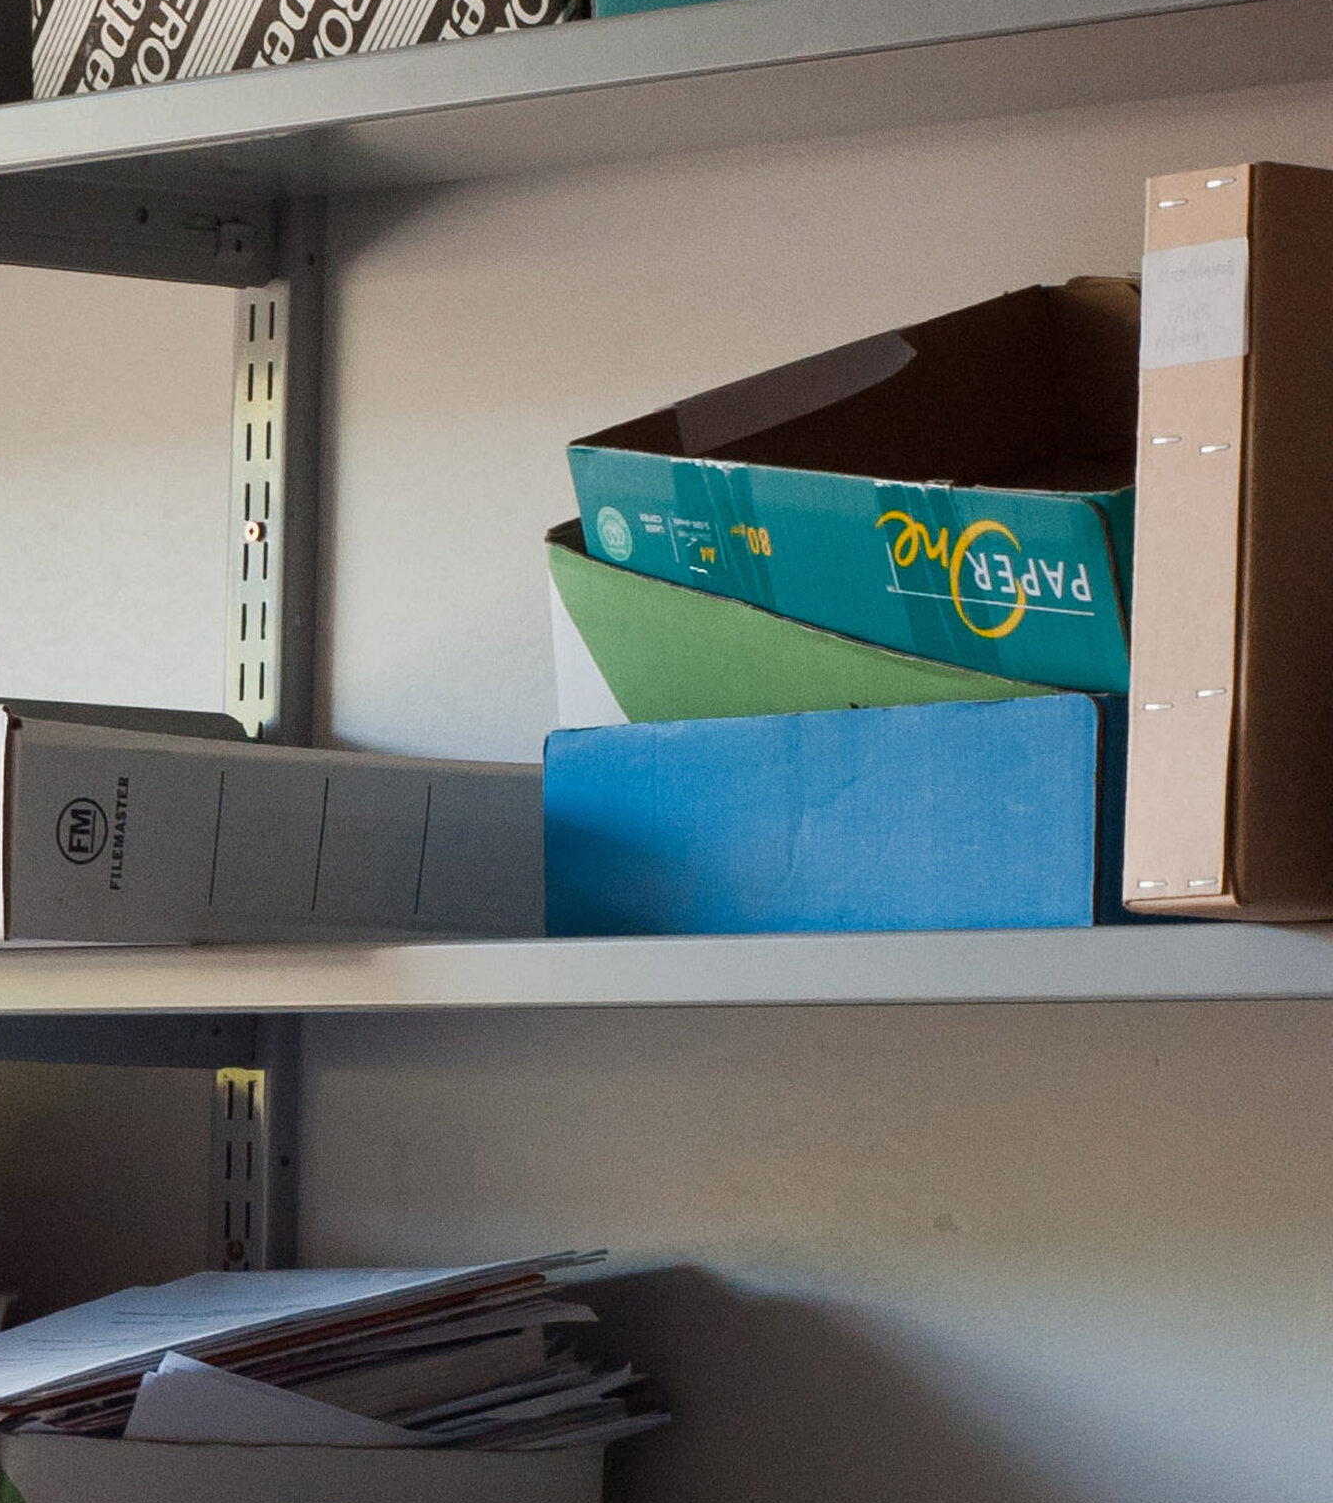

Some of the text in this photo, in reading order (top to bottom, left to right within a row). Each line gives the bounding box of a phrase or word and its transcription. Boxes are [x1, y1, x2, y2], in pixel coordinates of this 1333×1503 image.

[747, 527, 772, 556] 80
[964, 551, 1092, 602] PAPER
[68, 809, 91, 854] FM
[109, 776, 129, 891] FILEMASTER
